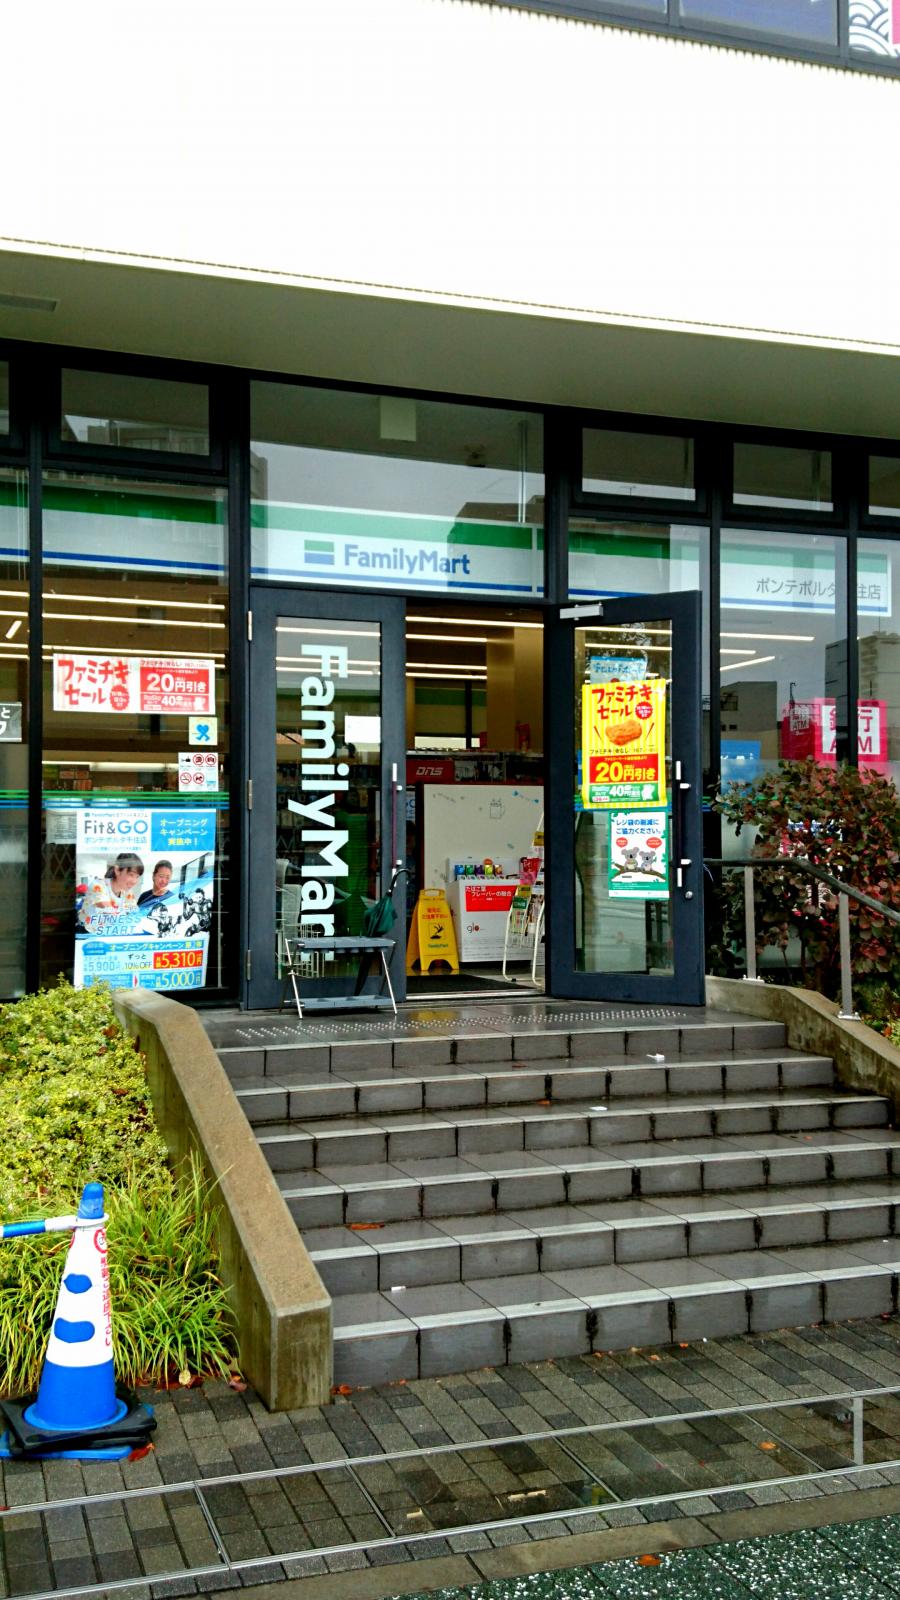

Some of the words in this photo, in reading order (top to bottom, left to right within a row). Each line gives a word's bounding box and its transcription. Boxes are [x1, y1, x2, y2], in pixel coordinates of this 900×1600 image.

[344, 544, 470, 575] FamilyMart
[58, 660, 129, 684] ファミチキ
[147, 674, 207, 692] 20円引き
[64, 684, 107, 706] セール
[591, 684, 653, 704] ファミチキ
[597, 705, 632, 720] セール
[595, 761, 657, 782] 20円引き
[288, 644, 349, 961] FamilyMar
[84, 819, 149, 835] Fit&GO
[159, 818, 209, 827] オープニング
[159, 828, 209, 837] キャンペーン
[90, 914, 142, 925] FITNESS
[96, 925, 137, 936] START
